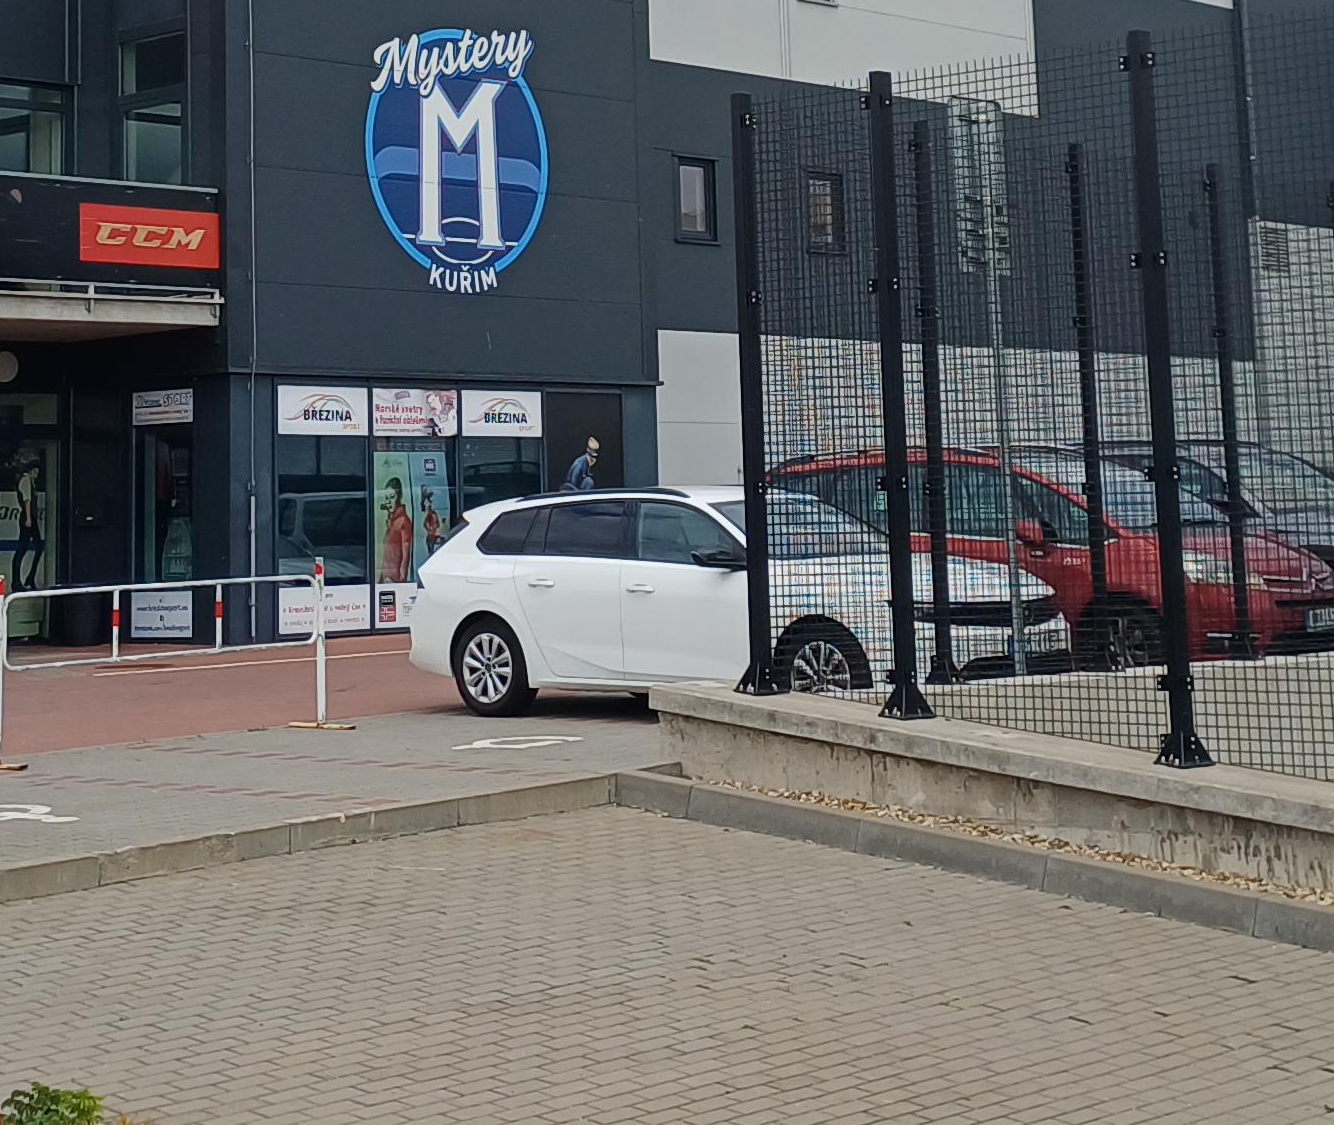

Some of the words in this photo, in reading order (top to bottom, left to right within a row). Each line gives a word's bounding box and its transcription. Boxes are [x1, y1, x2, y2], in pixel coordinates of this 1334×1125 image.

[370, 28, 534, 97] Mystery
[96, 221, 207, 250] CCM
[429, 266, 498, 294] KUŘIM
[303, 403, 352, 423] BŘEZINA
[484, 409, 528, 424] BŘEZINA
